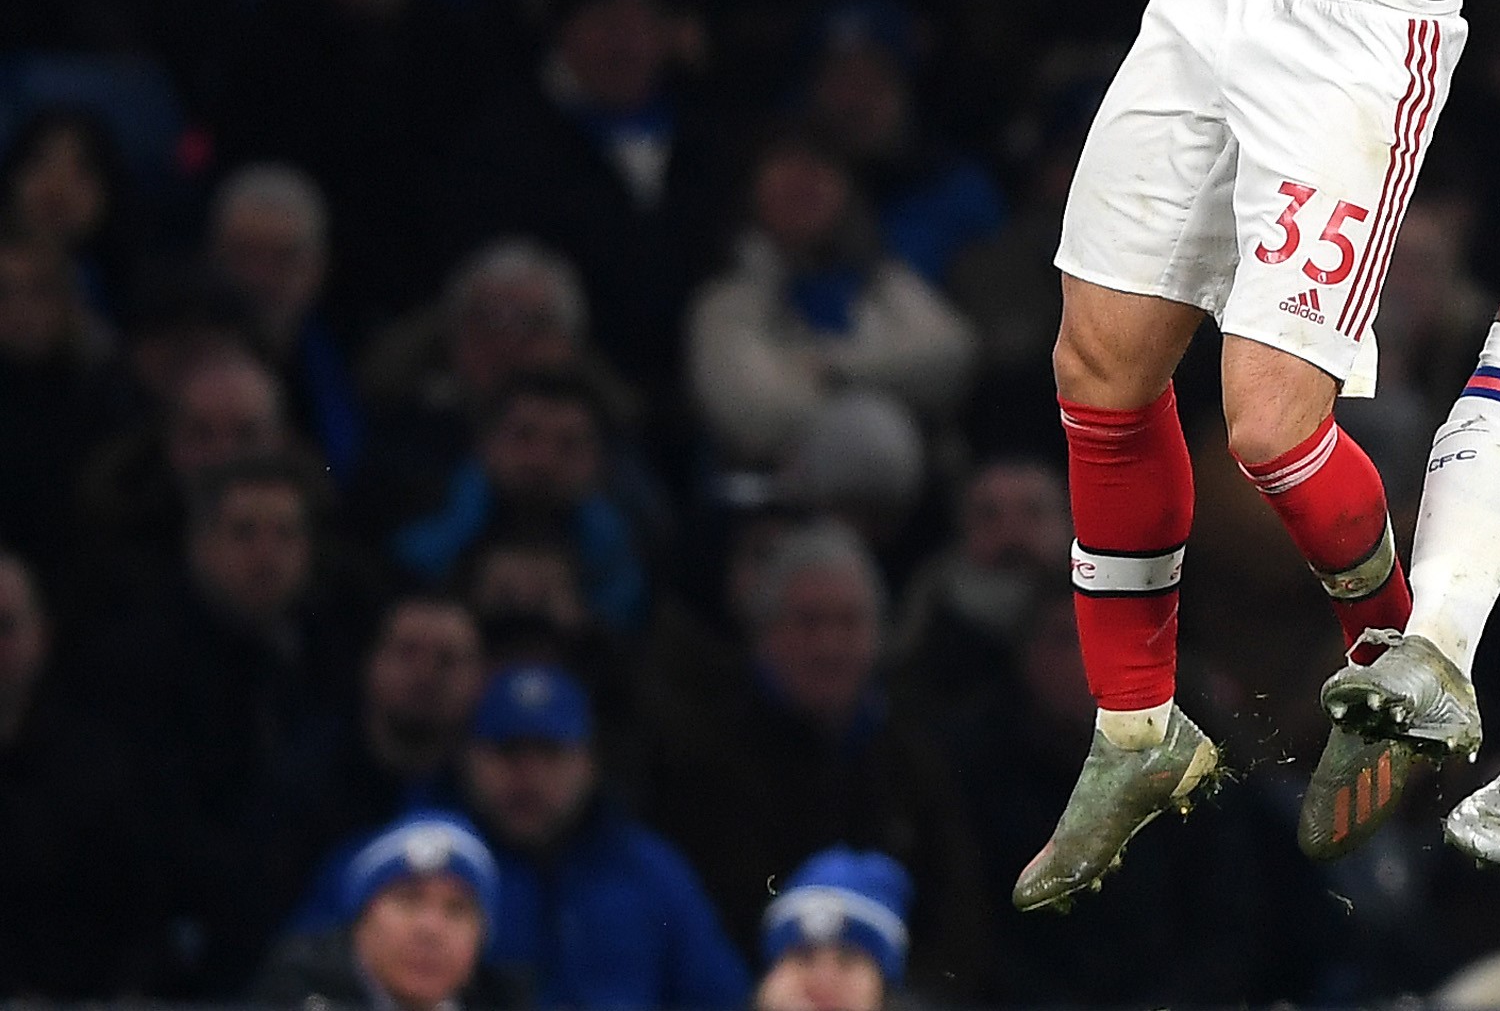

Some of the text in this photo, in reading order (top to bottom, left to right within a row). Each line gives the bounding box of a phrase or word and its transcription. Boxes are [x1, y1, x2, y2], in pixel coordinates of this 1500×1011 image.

[1254, 180, 1370, 285] 35
[1278, 300, 1325, 325] adidas
[1428, 449, 1477, 473] CFC
